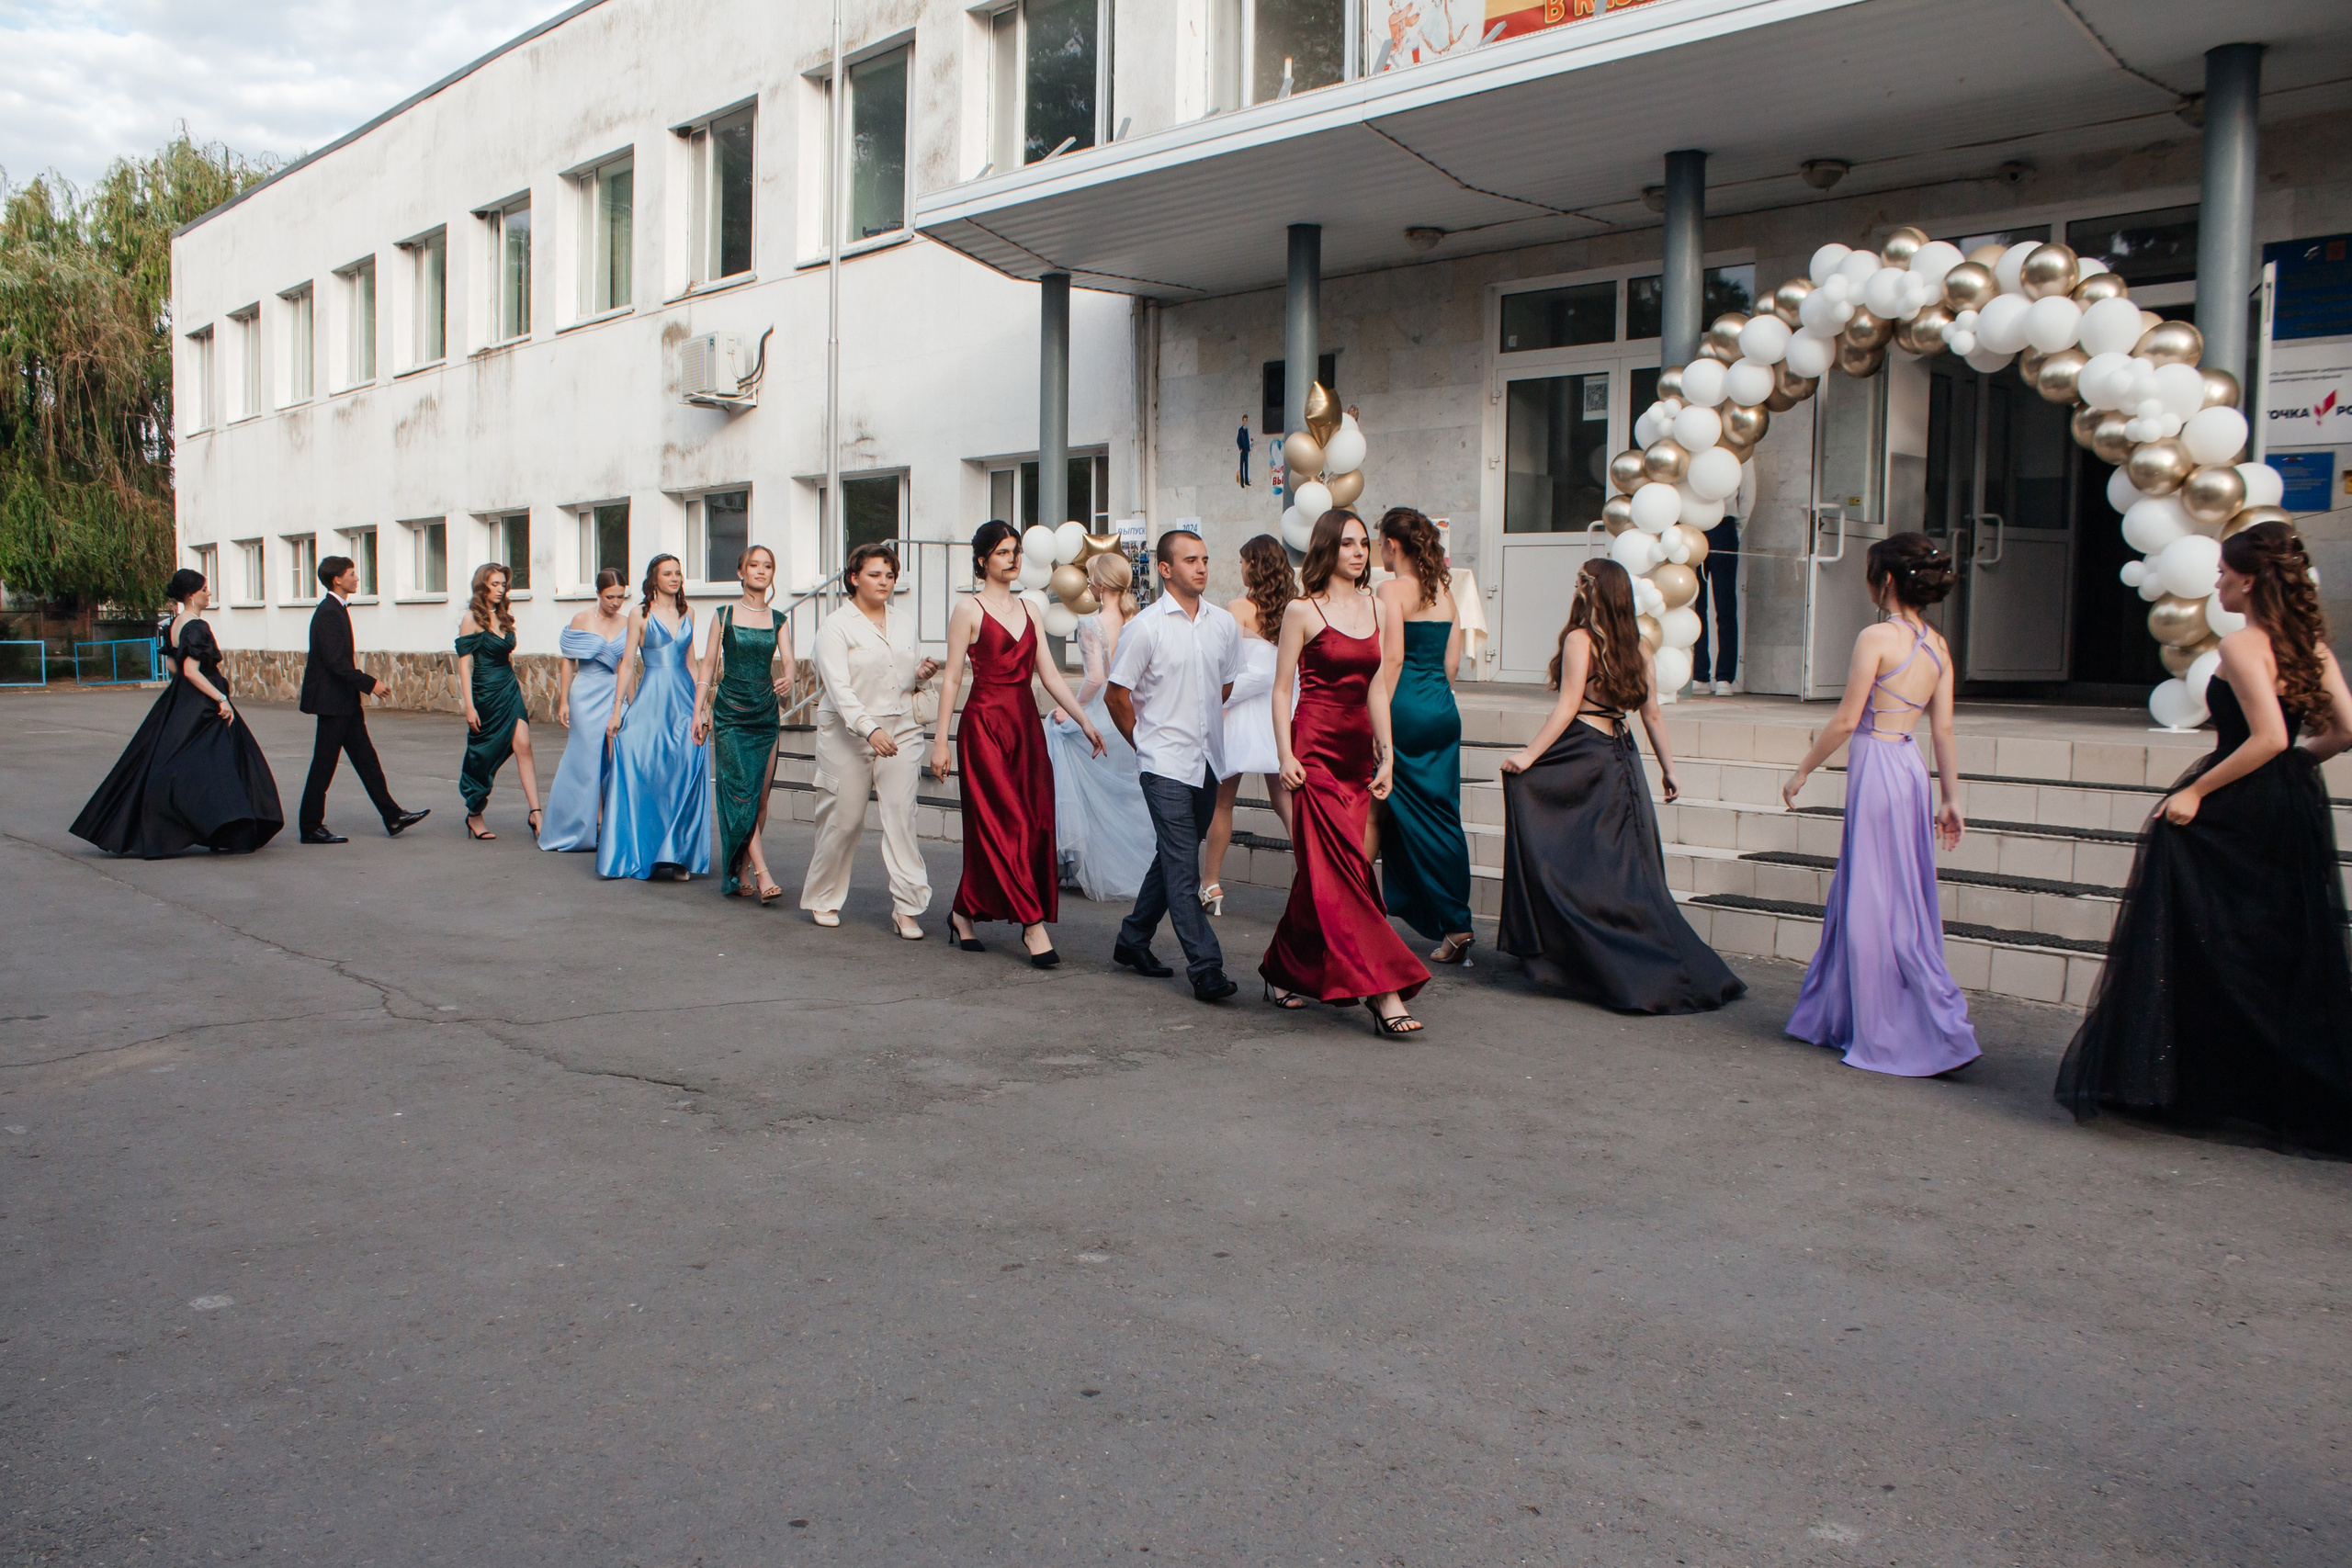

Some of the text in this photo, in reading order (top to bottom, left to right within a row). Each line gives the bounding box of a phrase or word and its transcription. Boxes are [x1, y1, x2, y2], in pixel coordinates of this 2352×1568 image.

[2267, 408, 2310, 420] ОЧКА
[1117, 526, 1146, 536] ВЫПУСК
[1182, 524, 1198, 533] 2024
